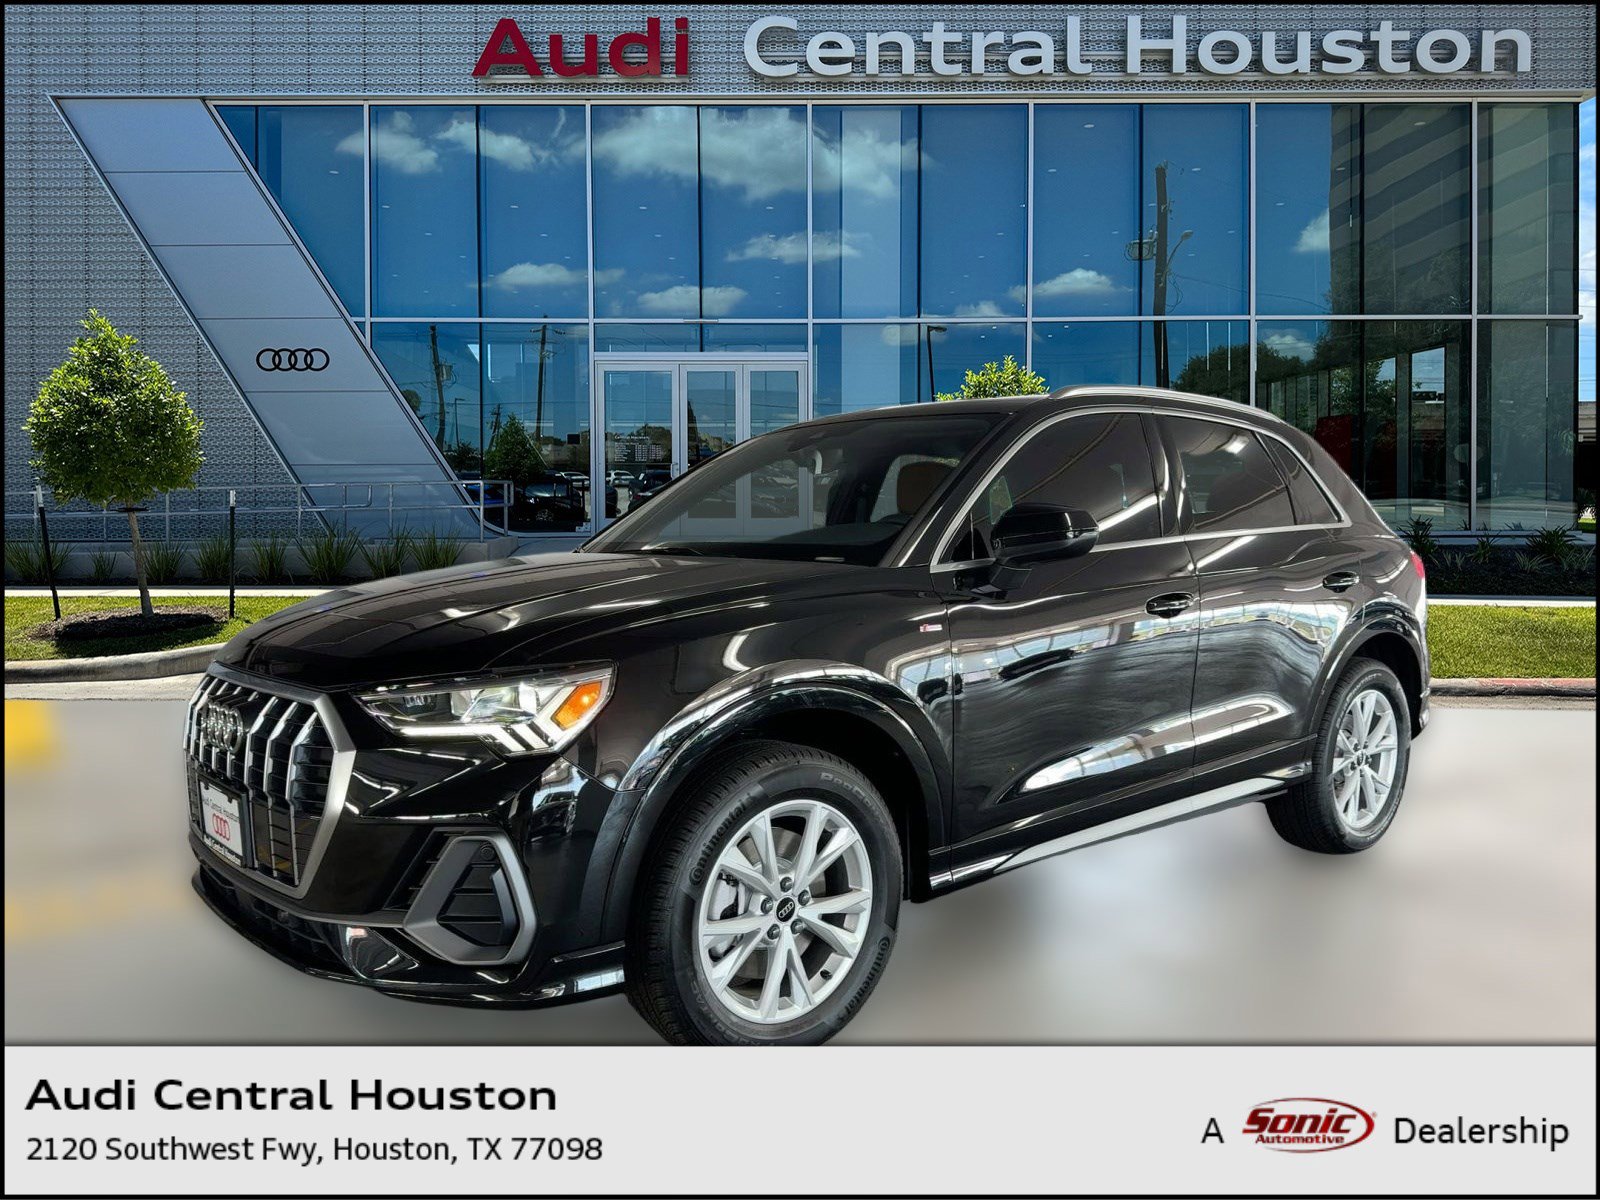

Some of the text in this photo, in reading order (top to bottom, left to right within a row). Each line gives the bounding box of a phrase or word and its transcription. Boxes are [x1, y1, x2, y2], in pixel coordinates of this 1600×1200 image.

[472, 14, 1532, 77] Audi Central Houston
[844, 936, 890, 1014] Continental
